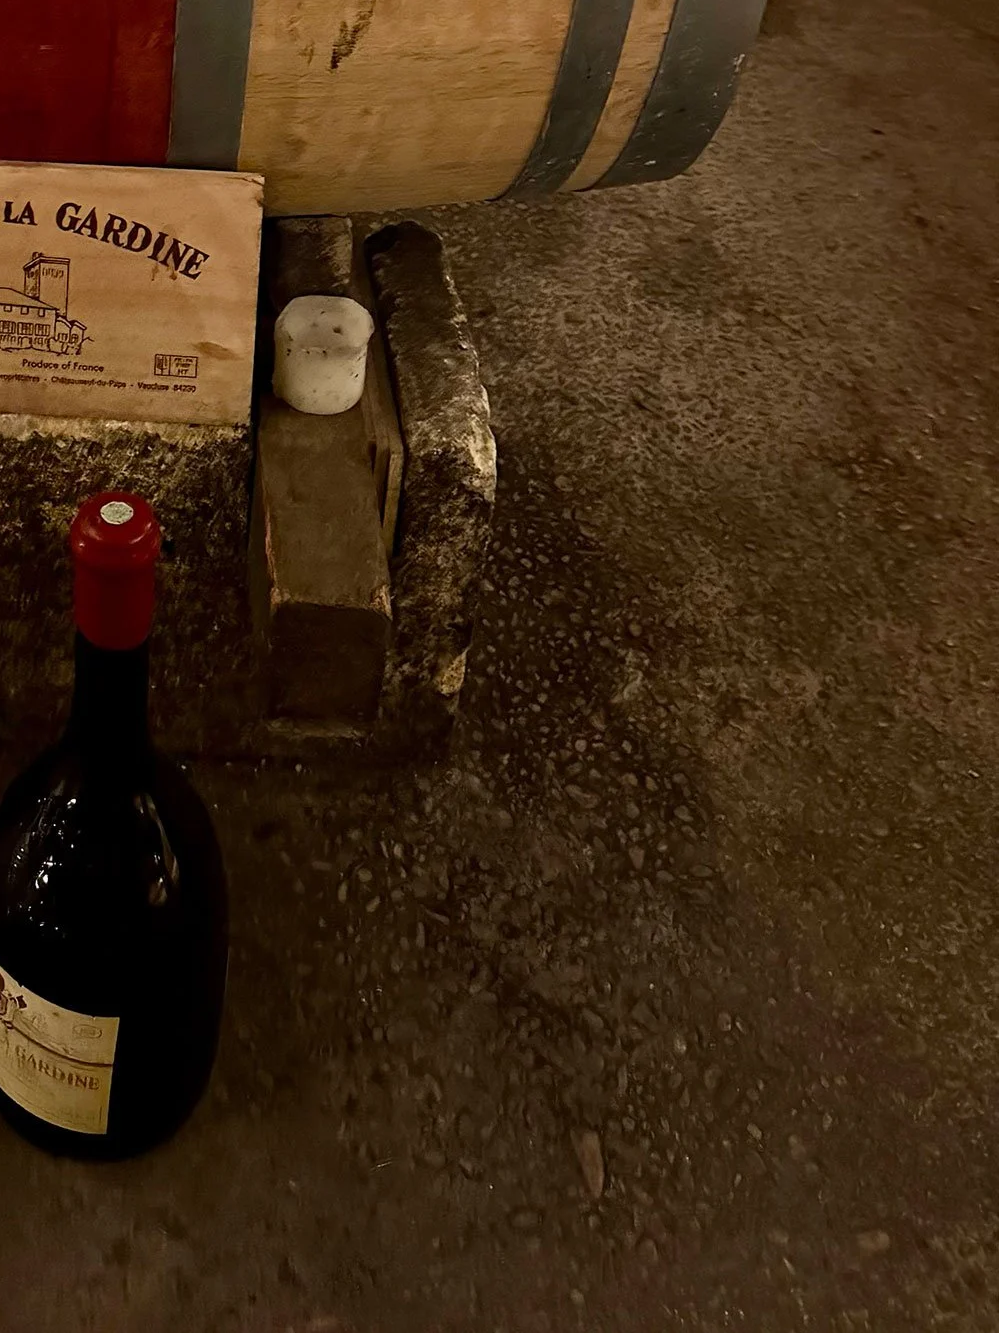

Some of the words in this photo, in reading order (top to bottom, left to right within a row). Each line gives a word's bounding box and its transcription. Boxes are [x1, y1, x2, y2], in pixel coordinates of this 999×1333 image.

[3, 200, 38, 226] LA
[55, 202, 210, 279] GARDINE
[22, 358, 58, 370] Produce
[61, 360, 71, 370] of
[73, 361, 104, 373] France
[15, 1046, 100, 1091] GARDINE
